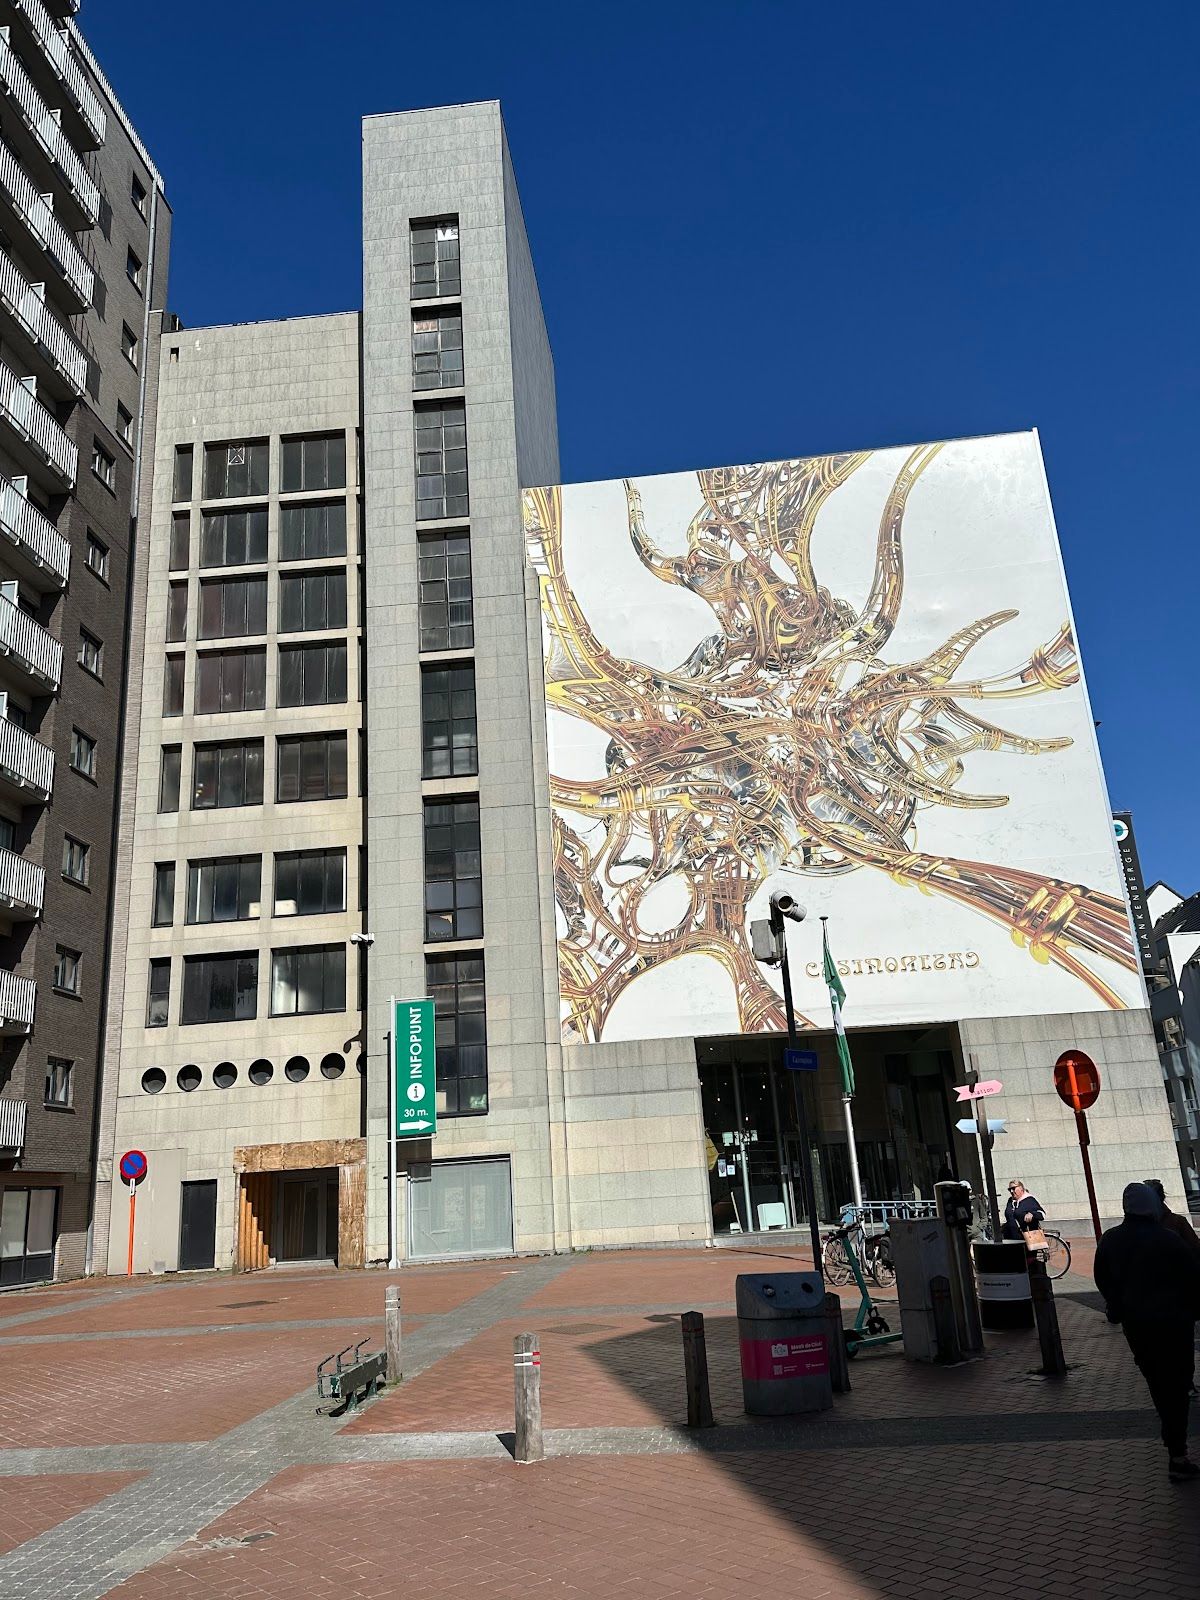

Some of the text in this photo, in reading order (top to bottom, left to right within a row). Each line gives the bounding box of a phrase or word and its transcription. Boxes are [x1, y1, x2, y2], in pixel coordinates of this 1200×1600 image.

[1123, 848, 1152, 959] BLANKENBERGE
[409, 1007, 423, 1079] INFOPUNT
[404, 1109, 429, 1118] 30 m.
